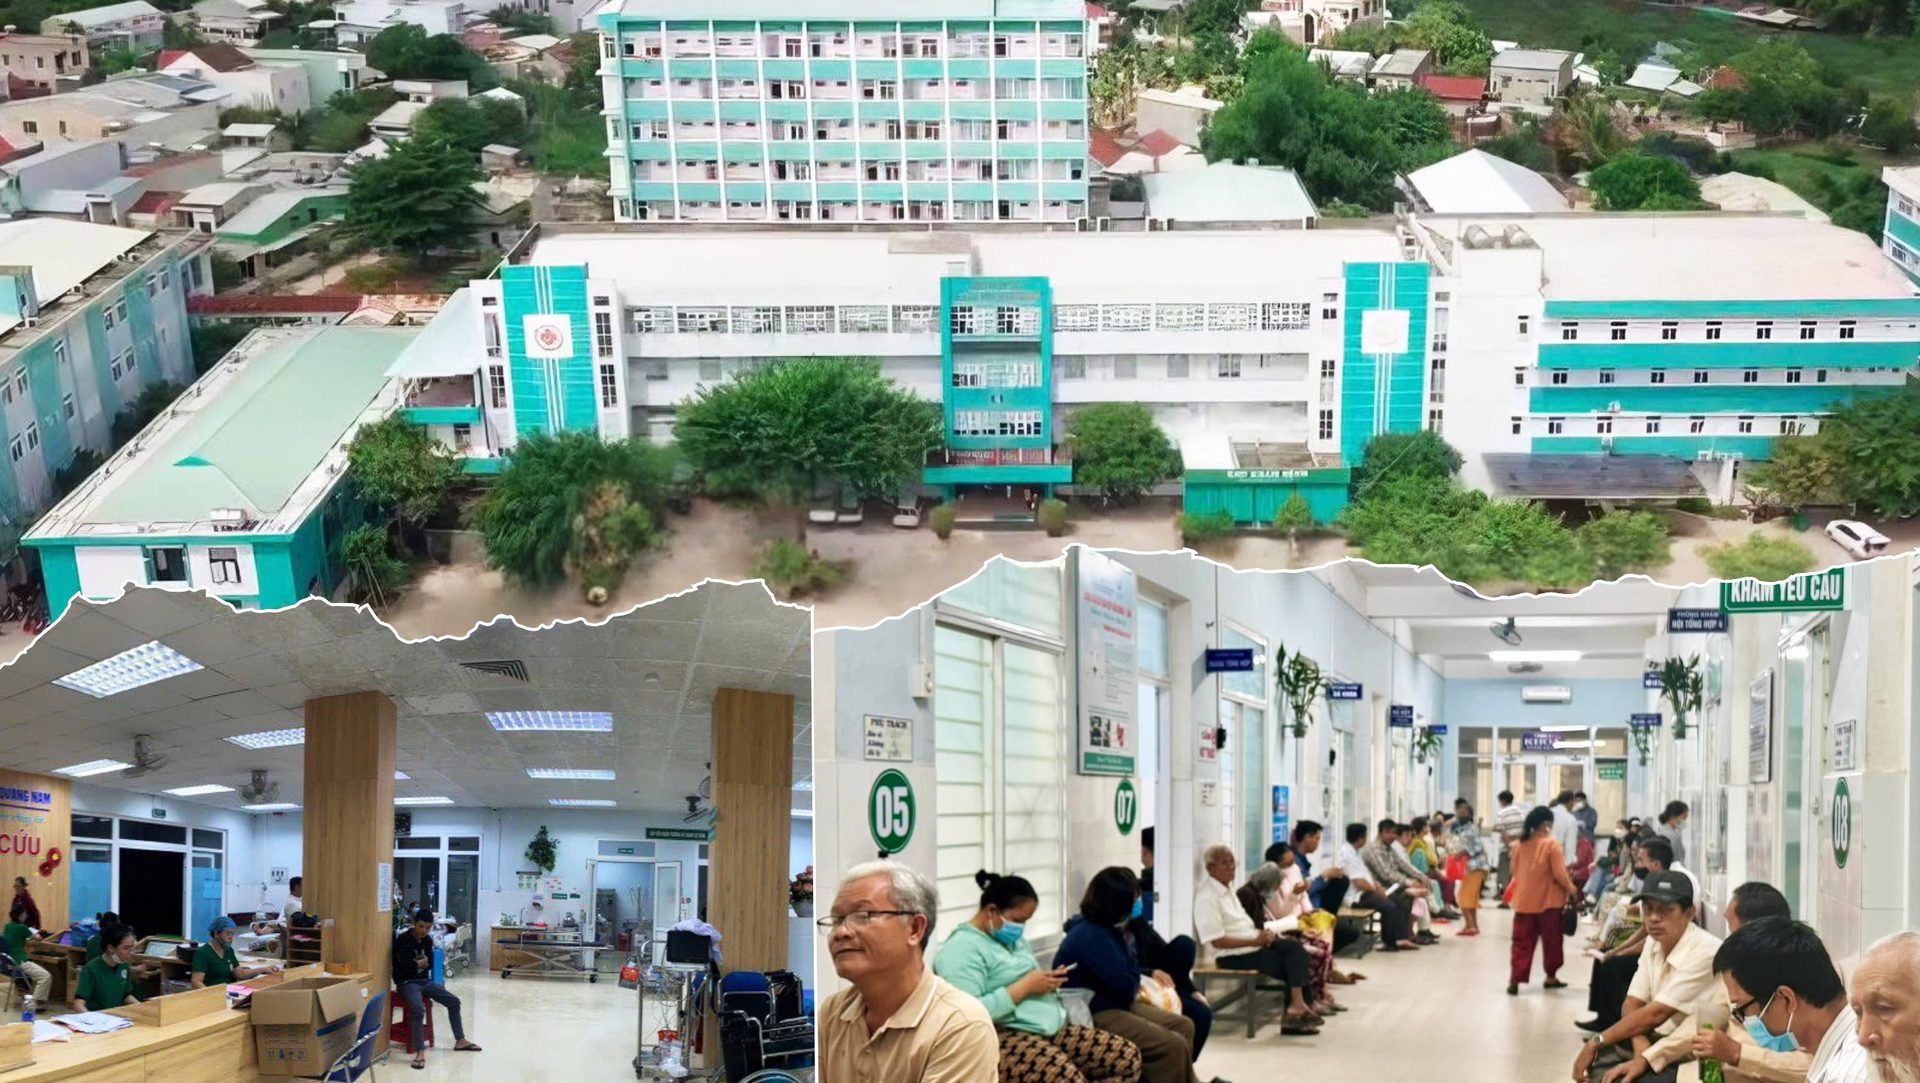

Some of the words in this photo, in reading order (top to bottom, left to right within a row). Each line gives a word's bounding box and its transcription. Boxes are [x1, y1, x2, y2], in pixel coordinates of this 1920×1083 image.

[876, 785, 909, 838] 05
[1117, 790, 1133, 825] 07
[1834, 794, 1848, 851] 08
